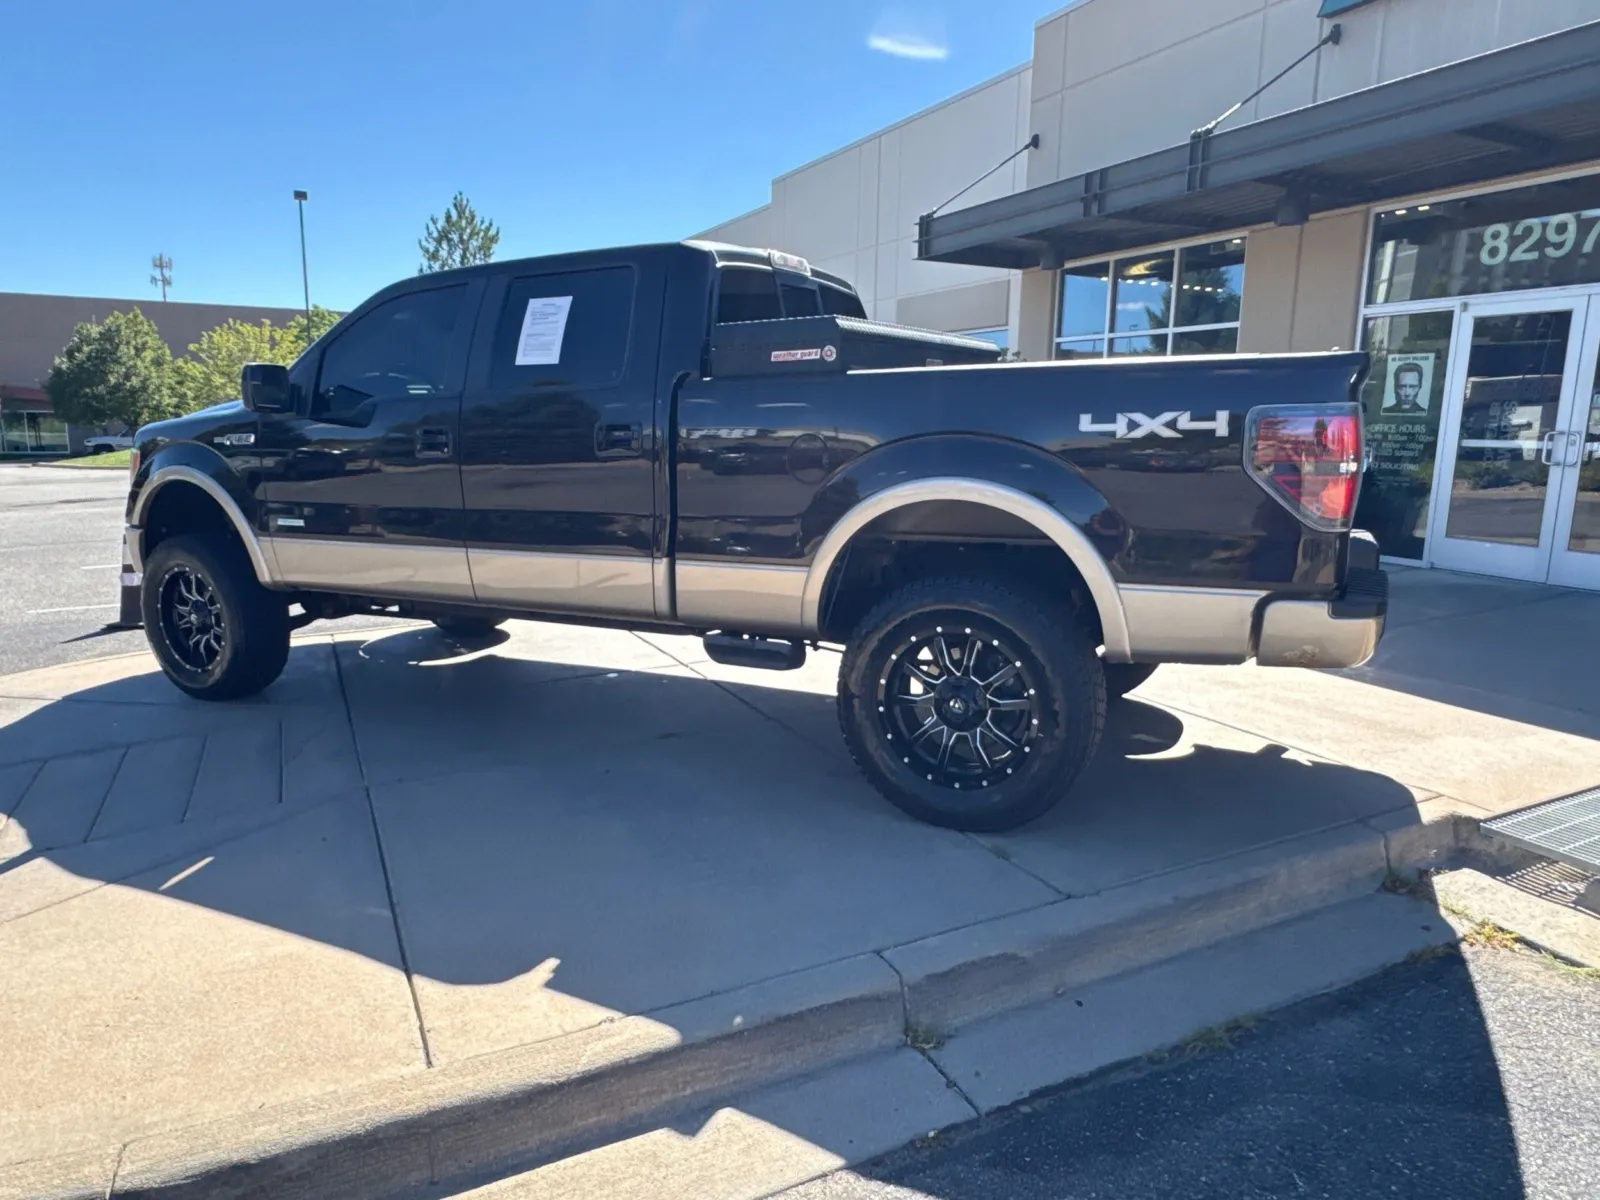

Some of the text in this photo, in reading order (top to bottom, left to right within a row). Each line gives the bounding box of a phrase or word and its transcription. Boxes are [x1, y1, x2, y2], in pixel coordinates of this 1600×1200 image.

[1480, 207, 1600, 265] 8297
[800, 349, 819, 359] guard
[1370, 423, 1426, 433] OFFICE HOURS
[1380, 462, 1419, 471] SOLICITING
